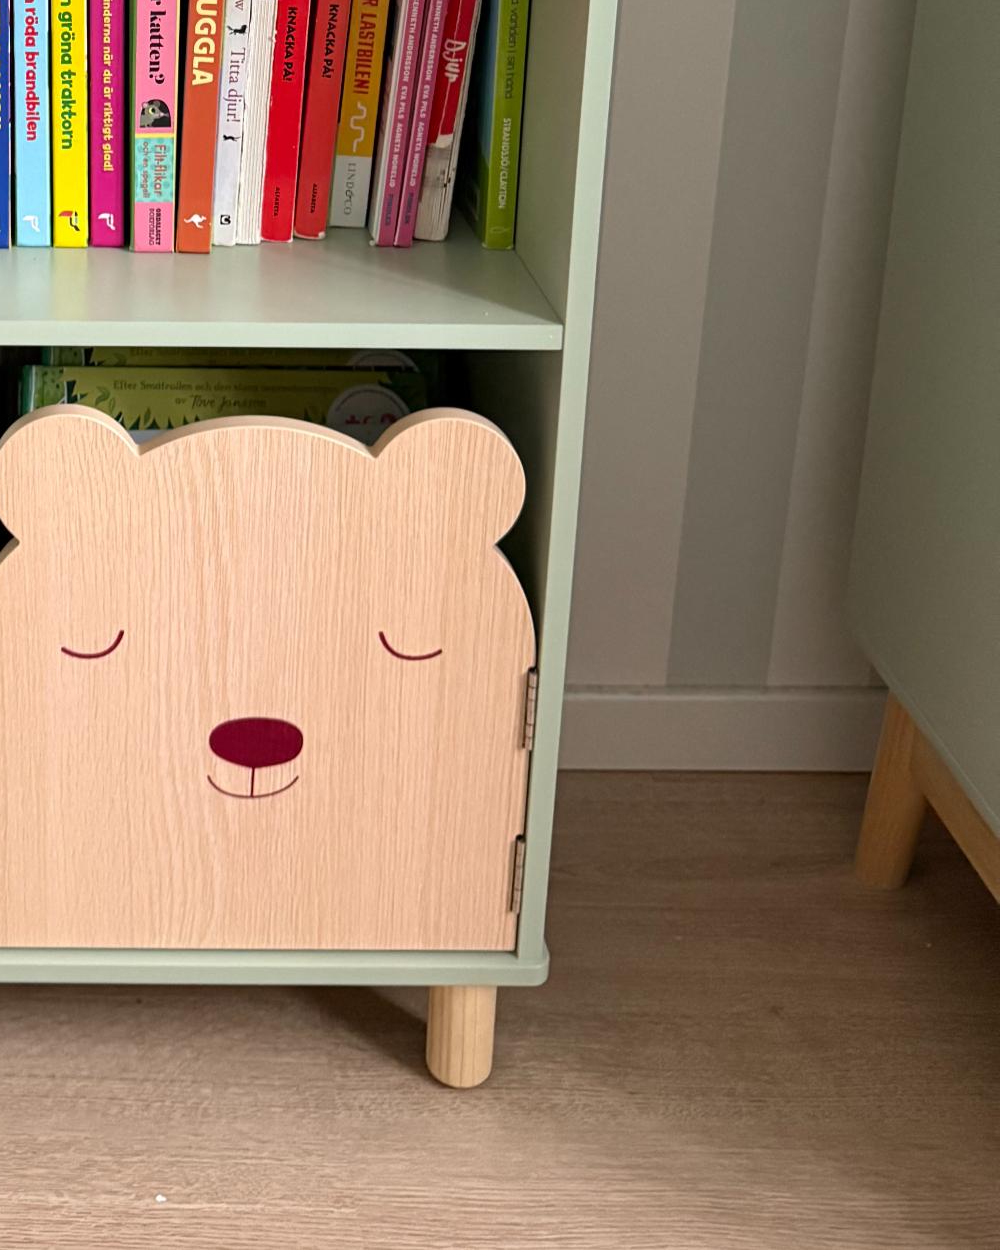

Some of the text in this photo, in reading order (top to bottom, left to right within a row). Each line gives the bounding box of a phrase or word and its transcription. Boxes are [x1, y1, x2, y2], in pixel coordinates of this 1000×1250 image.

[25, 7, 39, 47] röda
[58, 11, 76, 65] gröna
[284, 6, 298, 59] KNACKA
[324, 4, 340, 56] KNACKA
[103, 46, 113, 66] när
[149, 10, 167, 85] katten?
[402, 34, 415, 82] ANDERSSON
[425, 34, 438, 81] ANDERSSON
[442, 38, 468, 83] Djur
[103, 69, 113, 84] du
[282, 61, 295, 82] PÅ!
[321, 59, 335, 79] PÅ!
[25, 51, 41, 141] brandbilen
[103, 86, 113, 99] är
[223, 47, 246, 123] Titta djur!
[399, 85, 408, 101] EVA
[423, 85, 432, 100] EVA
[61, 69, 77, 150] traktorn
[102, 102, 114, 140] riktigt
[397, 102, 406, 120] PILS
[420, 101, 429, 119] PILS
[142, 141, 150, 156] och
[393, 122, 403, 152] AGNETA
[415, 121, 426, 151] AGNETA
[102, 143, 114, 172] glad!
[142, 157, 149, 168] en
[153, 144, 167, 196] Filt-flikar
[310, 183, 318, 213] ALFABETA
[343, 162, 357, 216] LIND&CO
[190, 394, 216, 409] Tove
